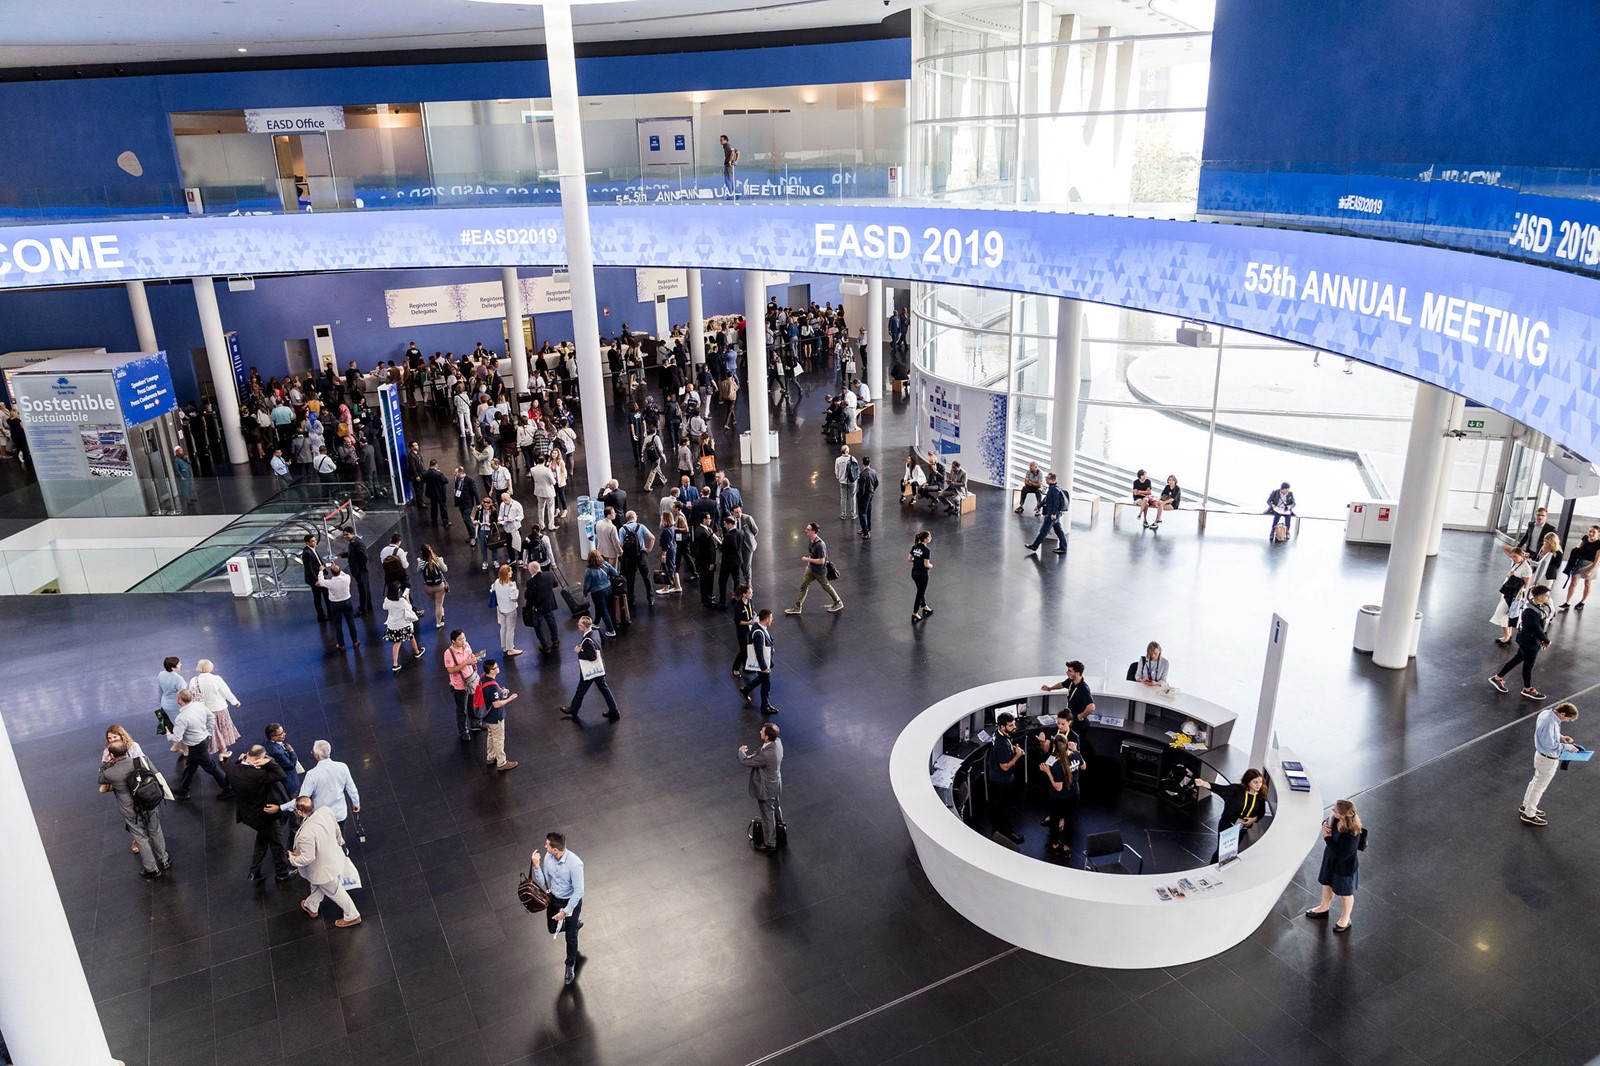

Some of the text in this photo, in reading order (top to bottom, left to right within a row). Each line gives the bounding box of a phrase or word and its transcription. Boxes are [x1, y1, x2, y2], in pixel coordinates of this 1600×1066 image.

[266, 118, 325, 130] EASD Office
[460, 228, 558, 246] #EASD2019
[815, 223, 1005, 268] EASD 2019
[409, 301, 438, 309] Registered
[1244, 261, 1550, 367] 55th ANNUAL MEETING
[20, 394, 115, 412] Sostenible
[23, 411, 89, 423] Sustainable
[494, 691, 500, 699] 3
